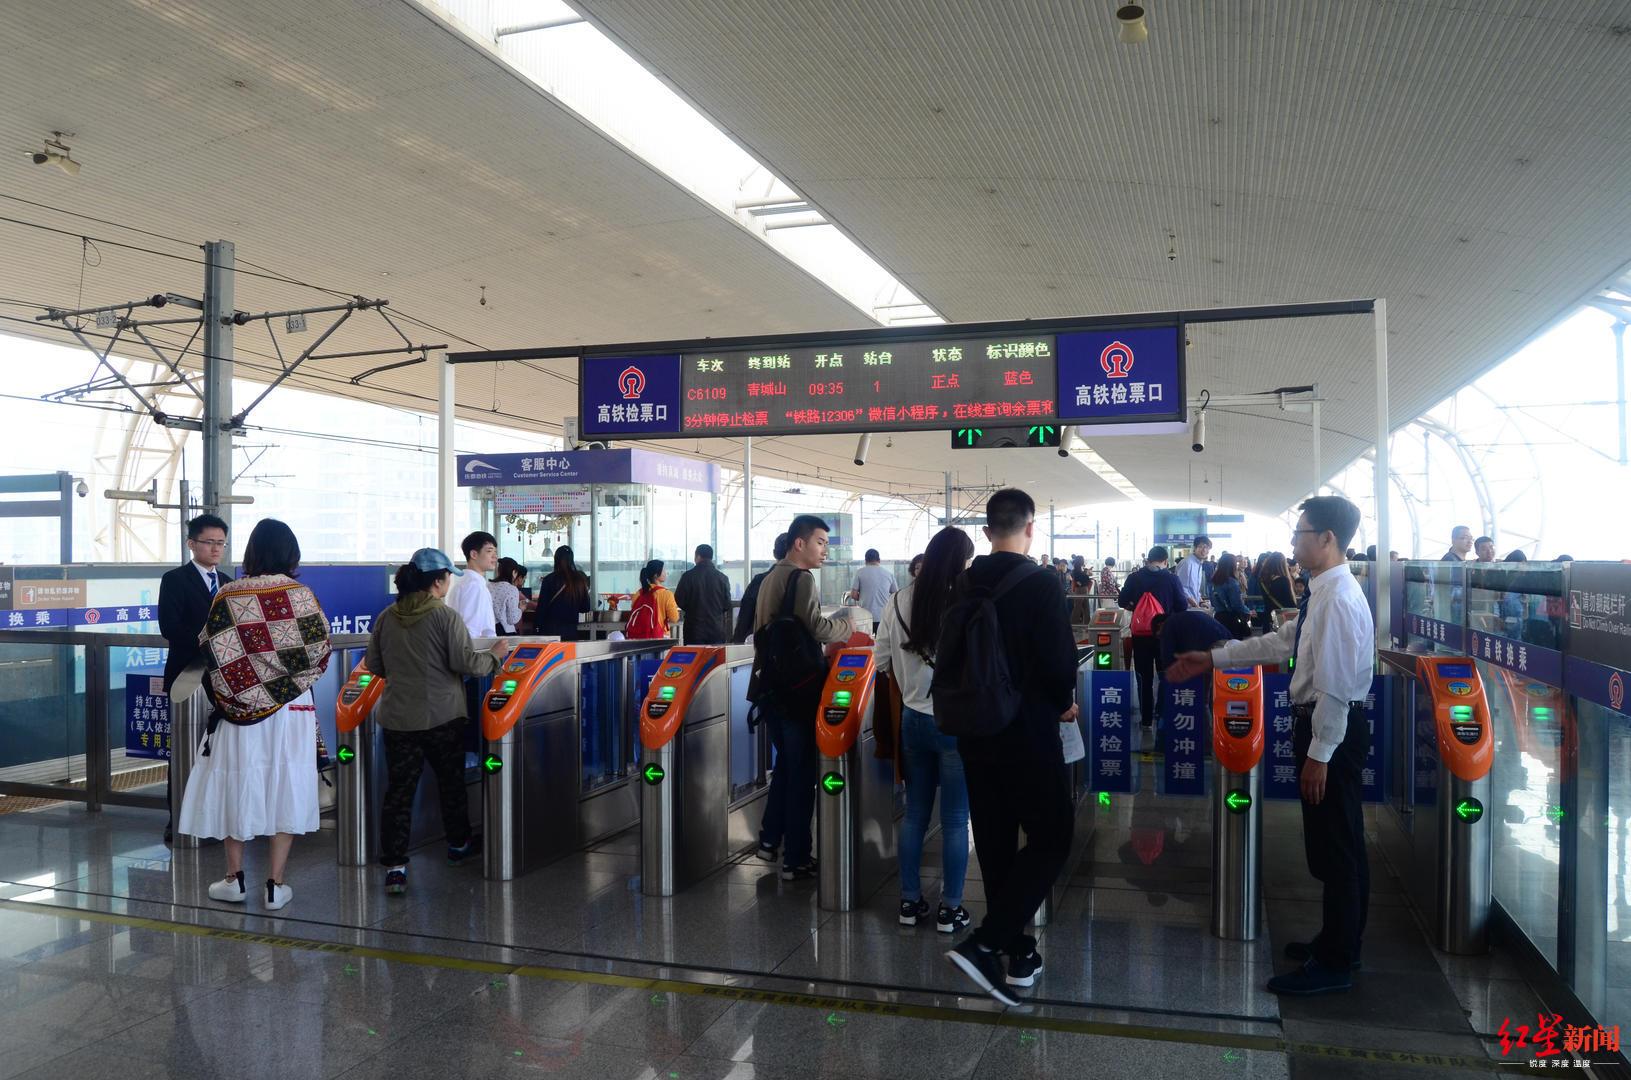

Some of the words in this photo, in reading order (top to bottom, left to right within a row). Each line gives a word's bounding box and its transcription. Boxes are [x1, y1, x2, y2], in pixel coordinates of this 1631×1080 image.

[697, 358, 724, 373] 车次
[748, 354, 791, 370] 终到站
[814, 352, 843, 369] 开点
[863, 350, 893, 366] 站台
[932, 347, 963, 362] 状态
[986, 342, 1051, 360] 标识颜色
[687, 387, 727, 401] C6109
[747, 381, 787, 397] 青城山
[808, 382, 844, 396] 09:35
[873, 380, 881, 393] 1
[931, 373, 960, 389] 正点
[1003, 370, 1035, 387] 蓝色
[1075, 382, 1162, 406] 高铁检票口
[598, 403, 667, 424] 高铁检票口
[521, 457, 571, 472] 客服中心
[8, 610, 50, 627] 换乘
[116, 607, 151, 621] 高铁
[1484, 636, 1528, 672] 高铁换乘
[1100, 687, 1123, 778] 高铁检票
[1172, 688, 1197, 780] 请勿冲撞
